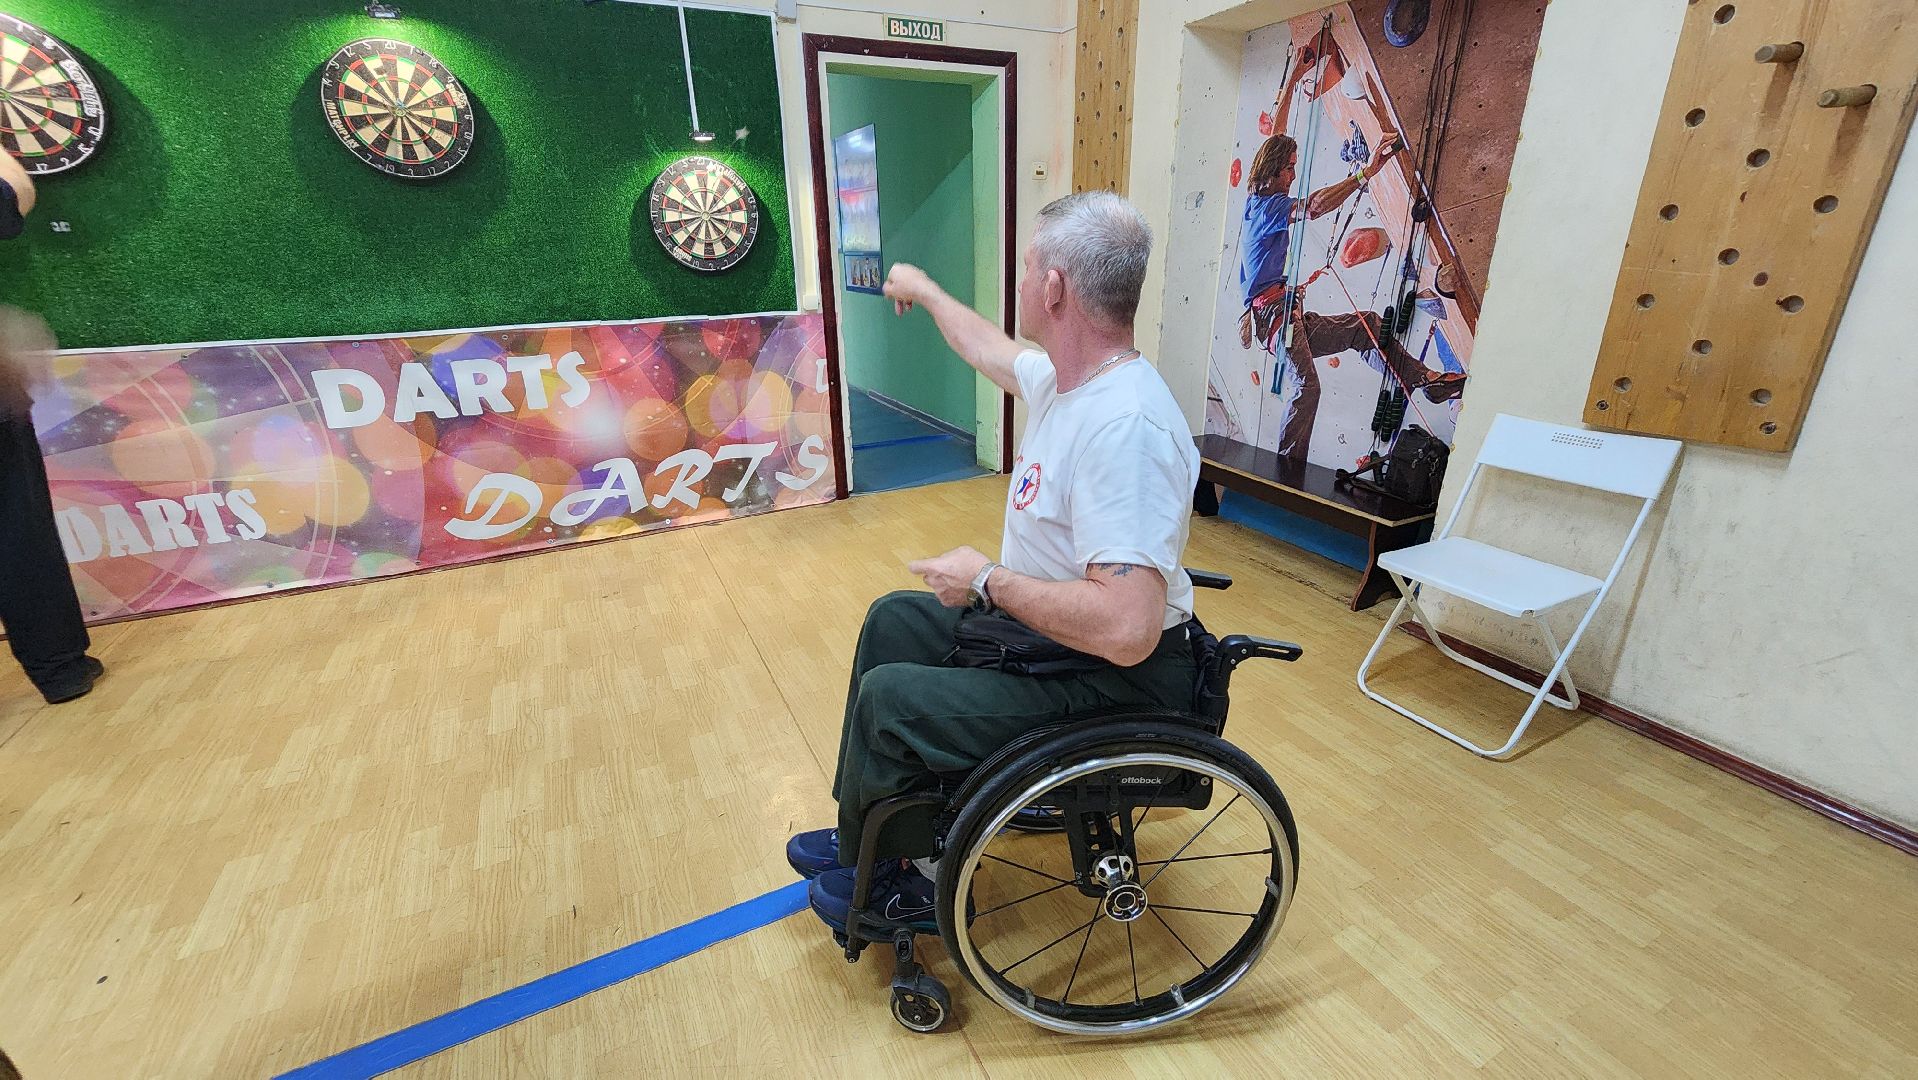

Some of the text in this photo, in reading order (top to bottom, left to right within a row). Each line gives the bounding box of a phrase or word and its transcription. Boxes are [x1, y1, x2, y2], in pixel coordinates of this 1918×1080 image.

[890, 20, 941, 40] ВЫХОД
[325, 100, 360, 149] MATCHPLAY
[310, 351, 590, 429] DARTS
[444, 435, 829, 539] DARTS
[55, 489, 267, 564] DARTS
